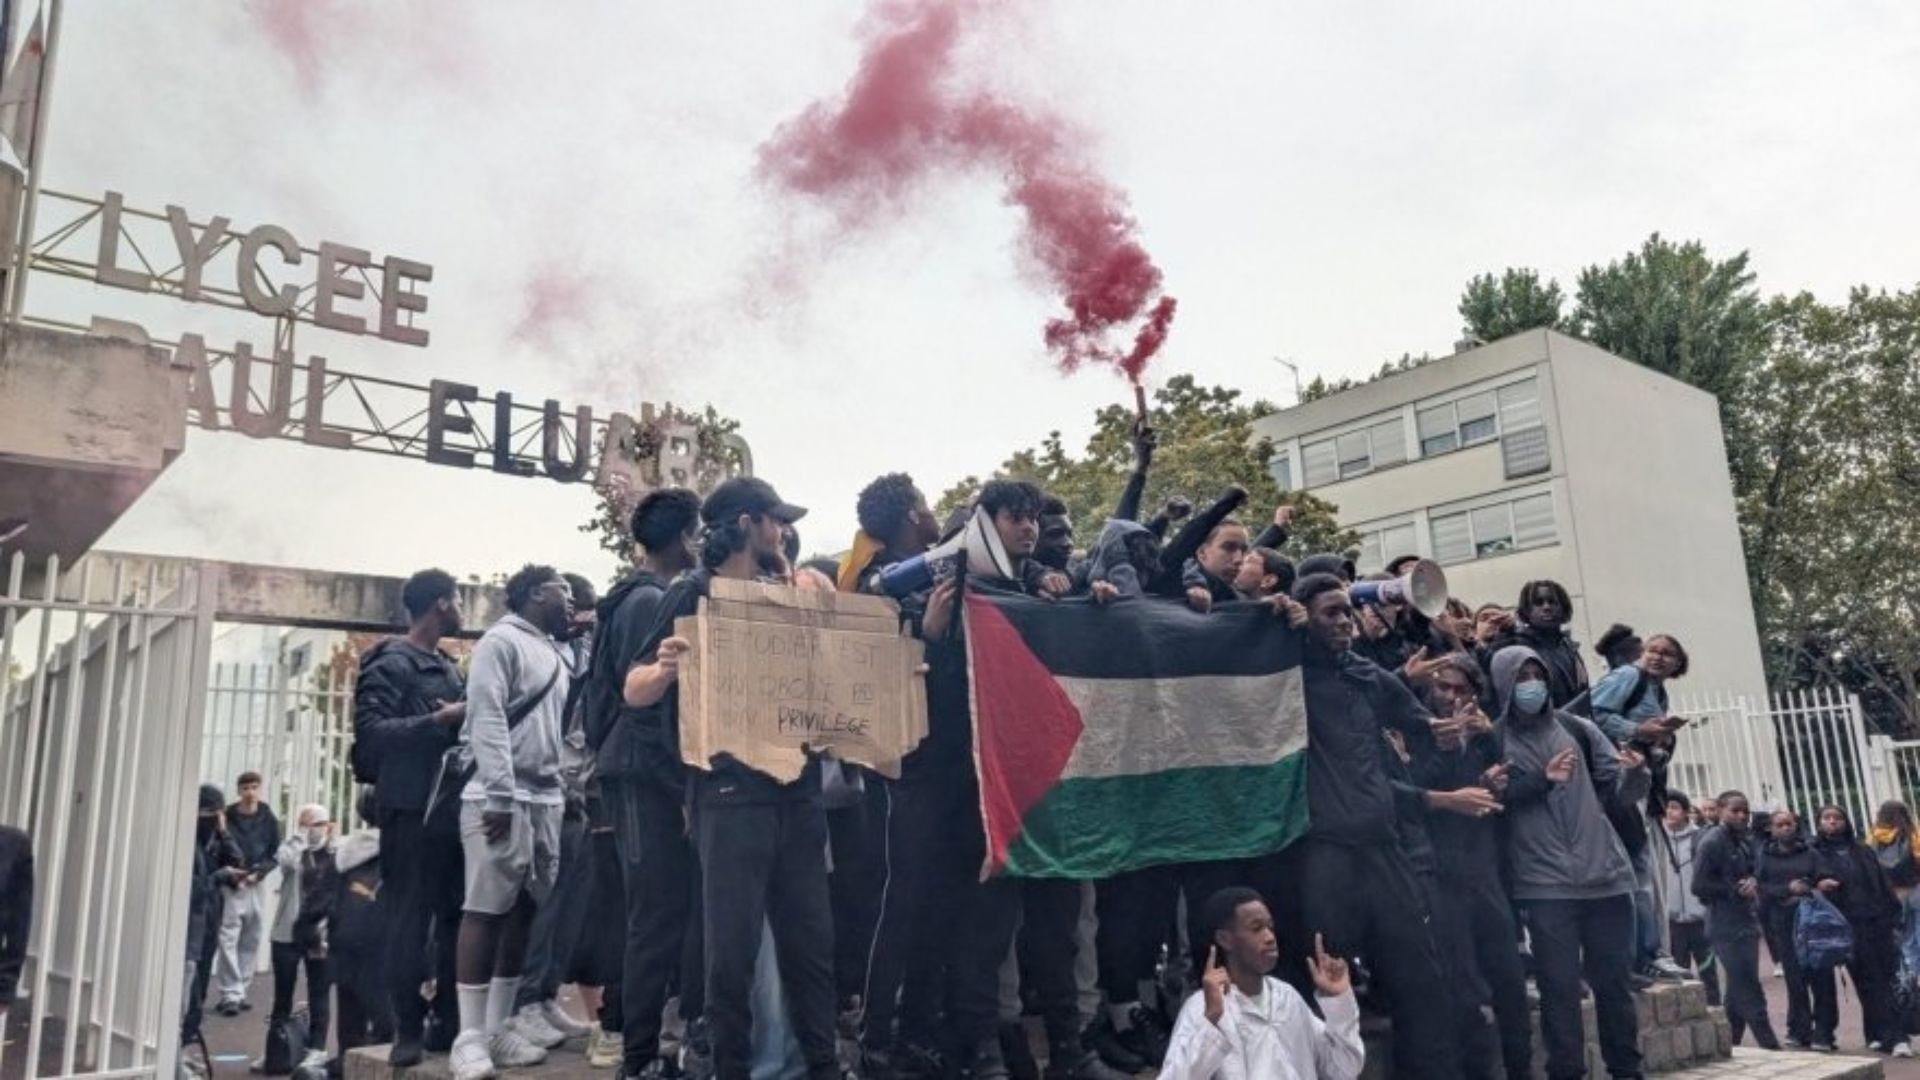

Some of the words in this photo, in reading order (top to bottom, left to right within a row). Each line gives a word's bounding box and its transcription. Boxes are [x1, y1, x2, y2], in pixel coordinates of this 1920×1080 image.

[95, 190, 433, 347] LYCEE
[92, 315, 353, 450] AUL
[777, 705, 870, 736] PRIVILEGE
